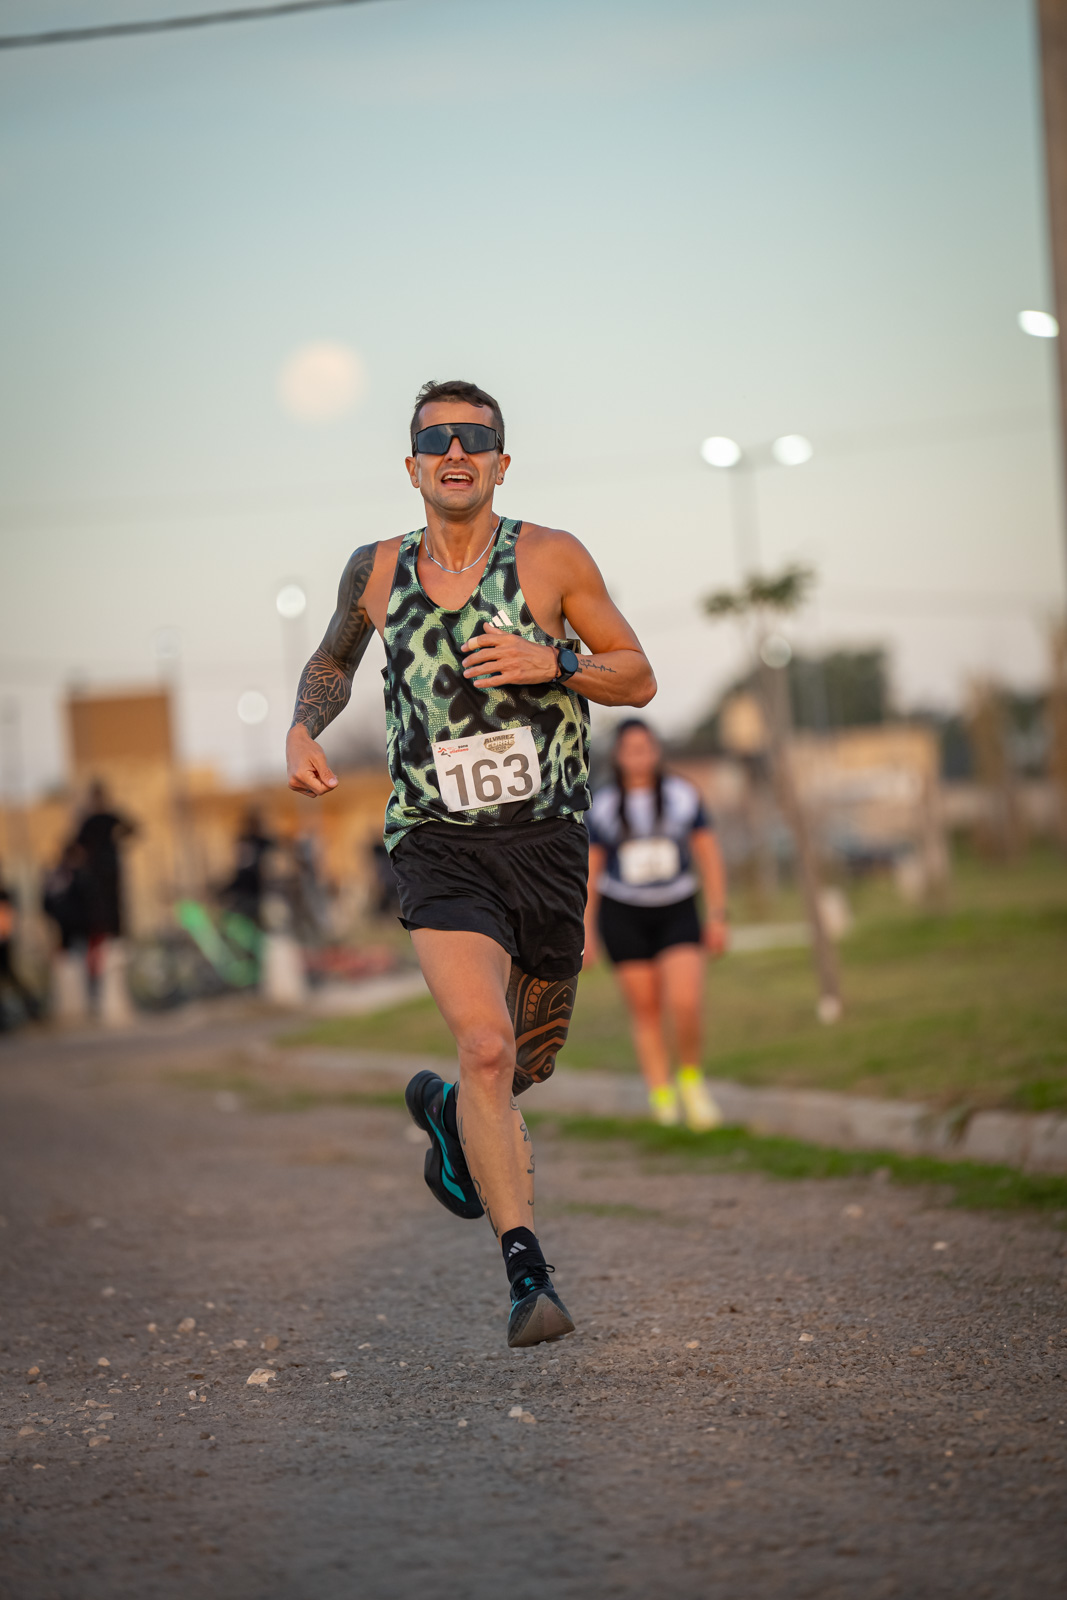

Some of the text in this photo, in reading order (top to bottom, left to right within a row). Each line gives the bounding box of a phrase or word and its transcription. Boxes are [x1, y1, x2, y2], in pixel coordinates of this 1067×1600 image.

[484, 733, 515, 744] ALVAREZ
[486, 739, 515, 748] CORRE
[445, 753, 533, 806] 163
